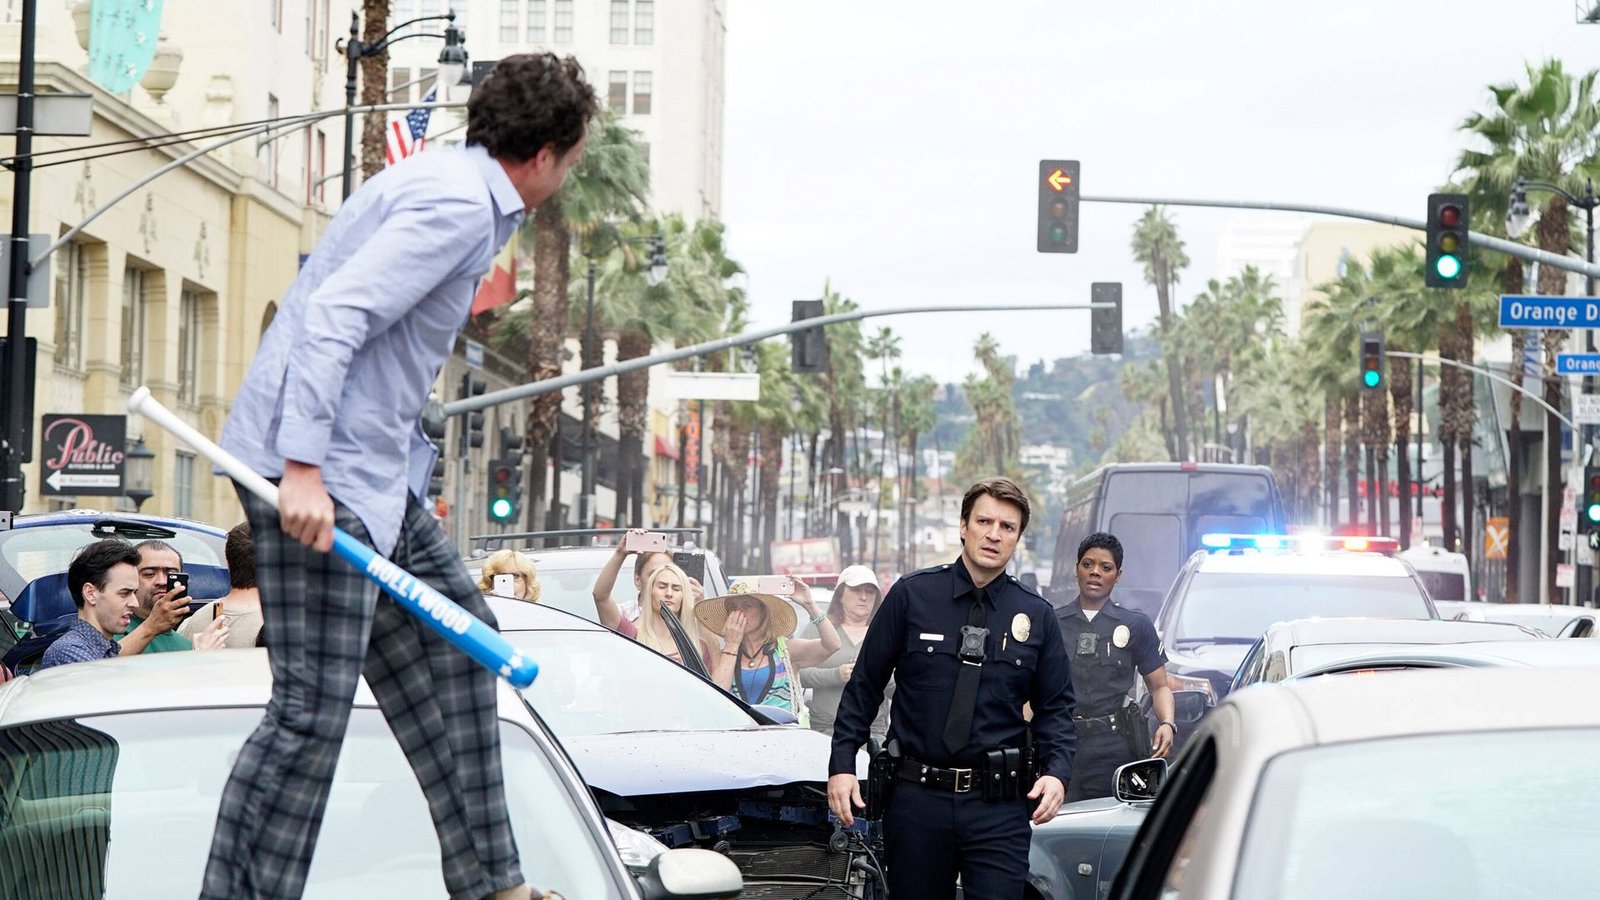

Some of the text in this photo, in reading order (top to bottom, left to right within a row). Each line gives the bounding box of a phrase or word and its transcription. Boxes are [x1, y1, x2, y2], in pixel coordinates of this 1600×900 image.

[1510, 301, 1600, 325] Orange D
[44, 418, 125, 470] Public
[366, 554, 473, 635] HOLLYWOOD
